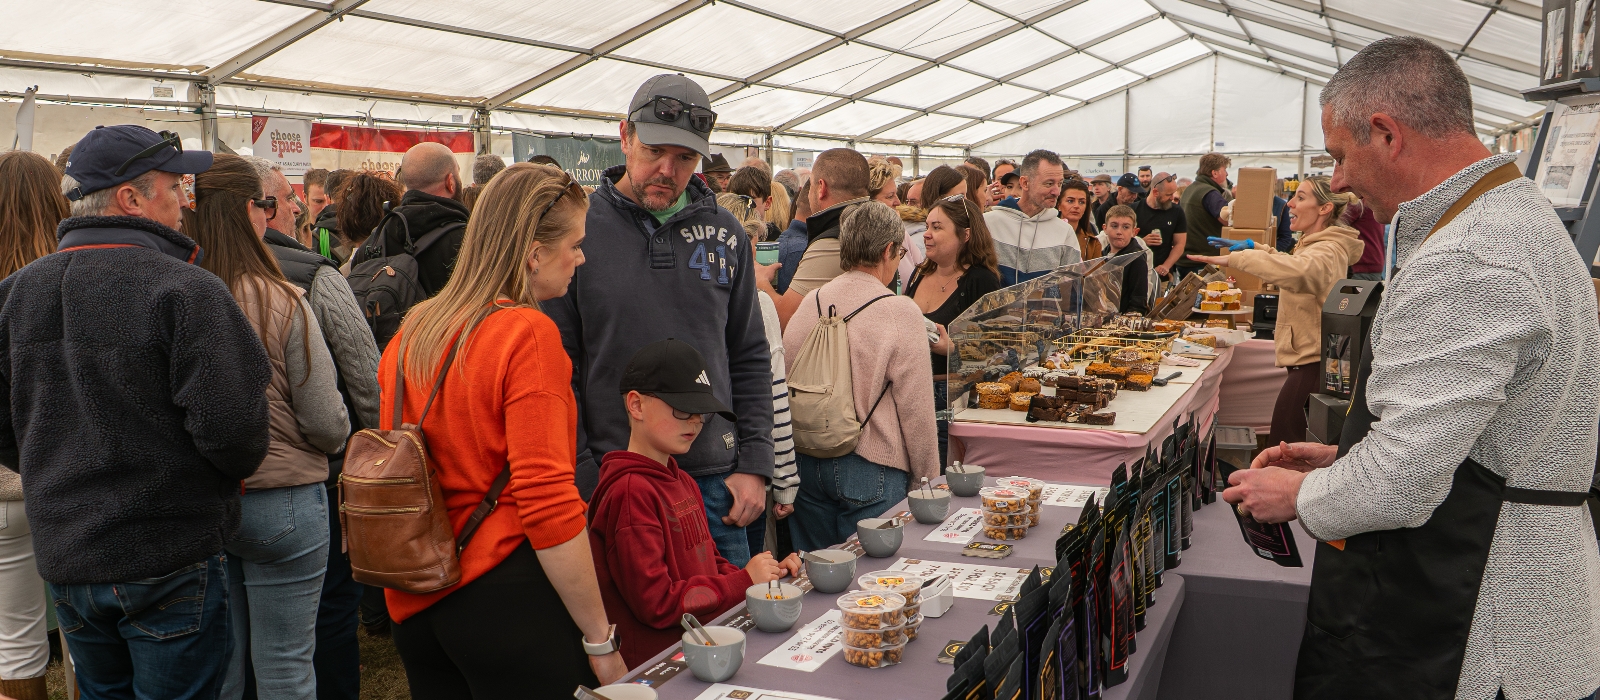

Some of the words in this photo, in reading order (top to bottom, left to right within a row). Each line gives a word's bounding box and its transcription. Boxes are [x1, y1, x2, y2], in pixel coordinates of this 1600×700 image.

[270, 129, 301, 141] choose
[271, 139, 303, 158] spice
[361, 158, 401, 171] choose
[679, 224, 738, 251] SUPER
[688, 242, 729, 284] 41
